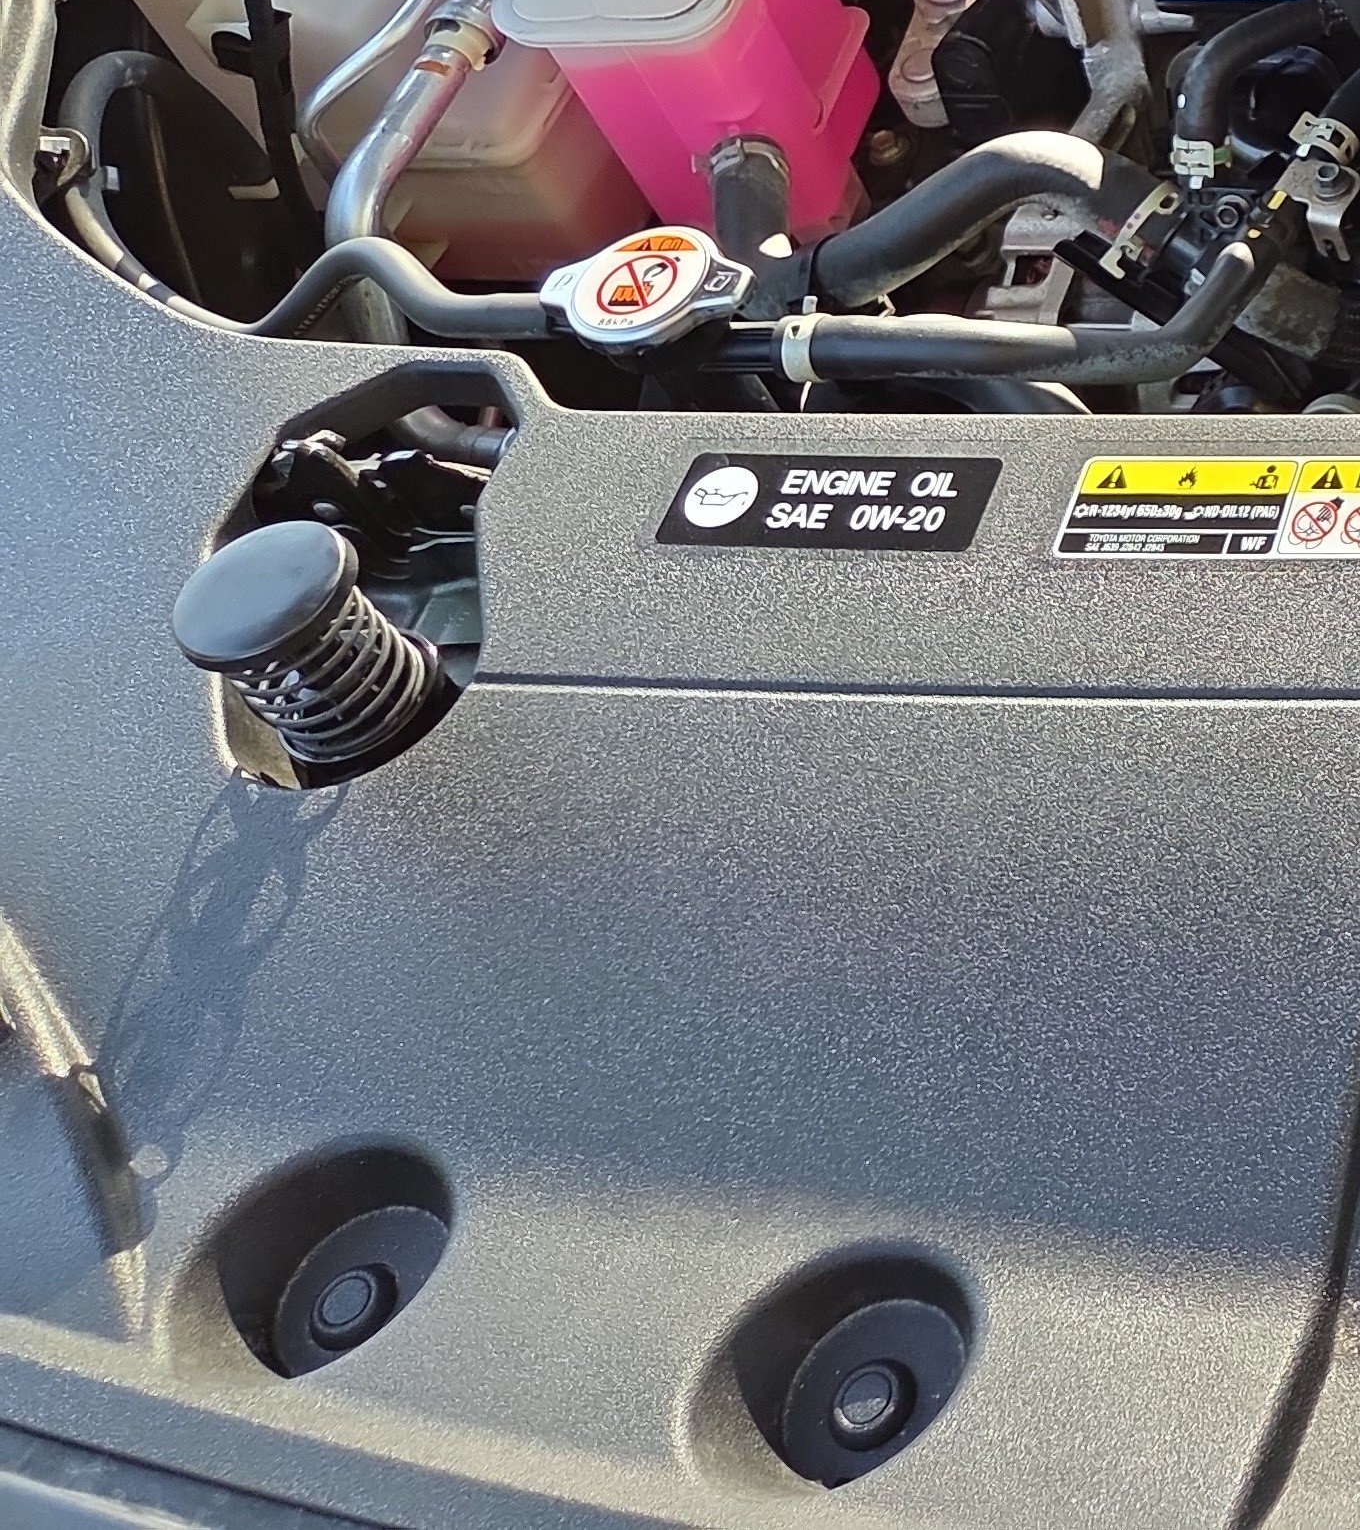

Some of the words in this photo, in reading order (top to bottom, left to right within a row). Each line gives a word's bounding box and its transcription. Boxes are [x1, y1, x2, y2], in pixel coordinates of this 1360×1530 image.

[780, 468, 897, 496] ENGINE
[909, 471, 960, 498] OIL
[766, 503, 835, 530] SAE
[849, 504, 947, 532] 0W-20
[1089, 533, 1119, 543] TOYOTA
[1118, 534, 1147, 543] MOTOR
[1146, 534, 1201, 544] CORPORATION
[1240, 536, 1267, 551] WF
